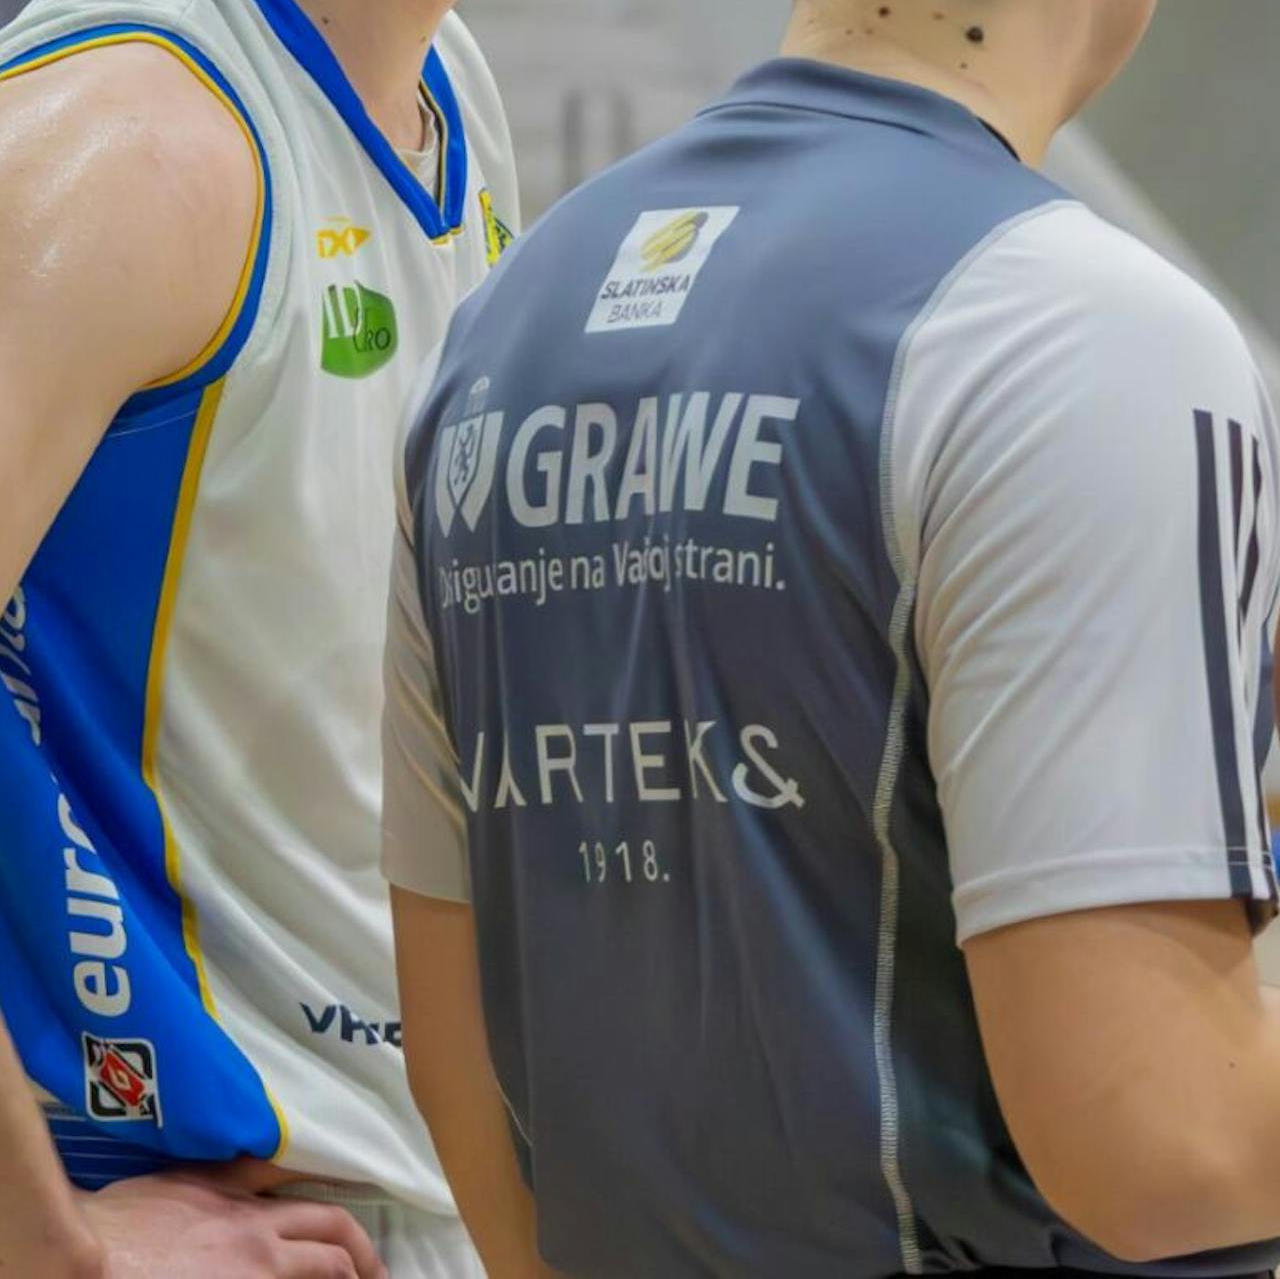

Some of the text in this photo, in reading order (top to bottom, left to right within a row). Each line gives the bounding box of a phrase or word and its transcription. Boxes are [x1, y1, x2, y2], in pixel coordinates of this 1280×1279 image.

[600, 275, 691, 300] SLATINSKA
[606, 302, 663, 323] BANKA
[505, 392, 801, 529] GRAWE
[570, 553, 606, 592] na
[674, 537, 787, 591] strani.
[578, 839, 671, 884] 1918.
